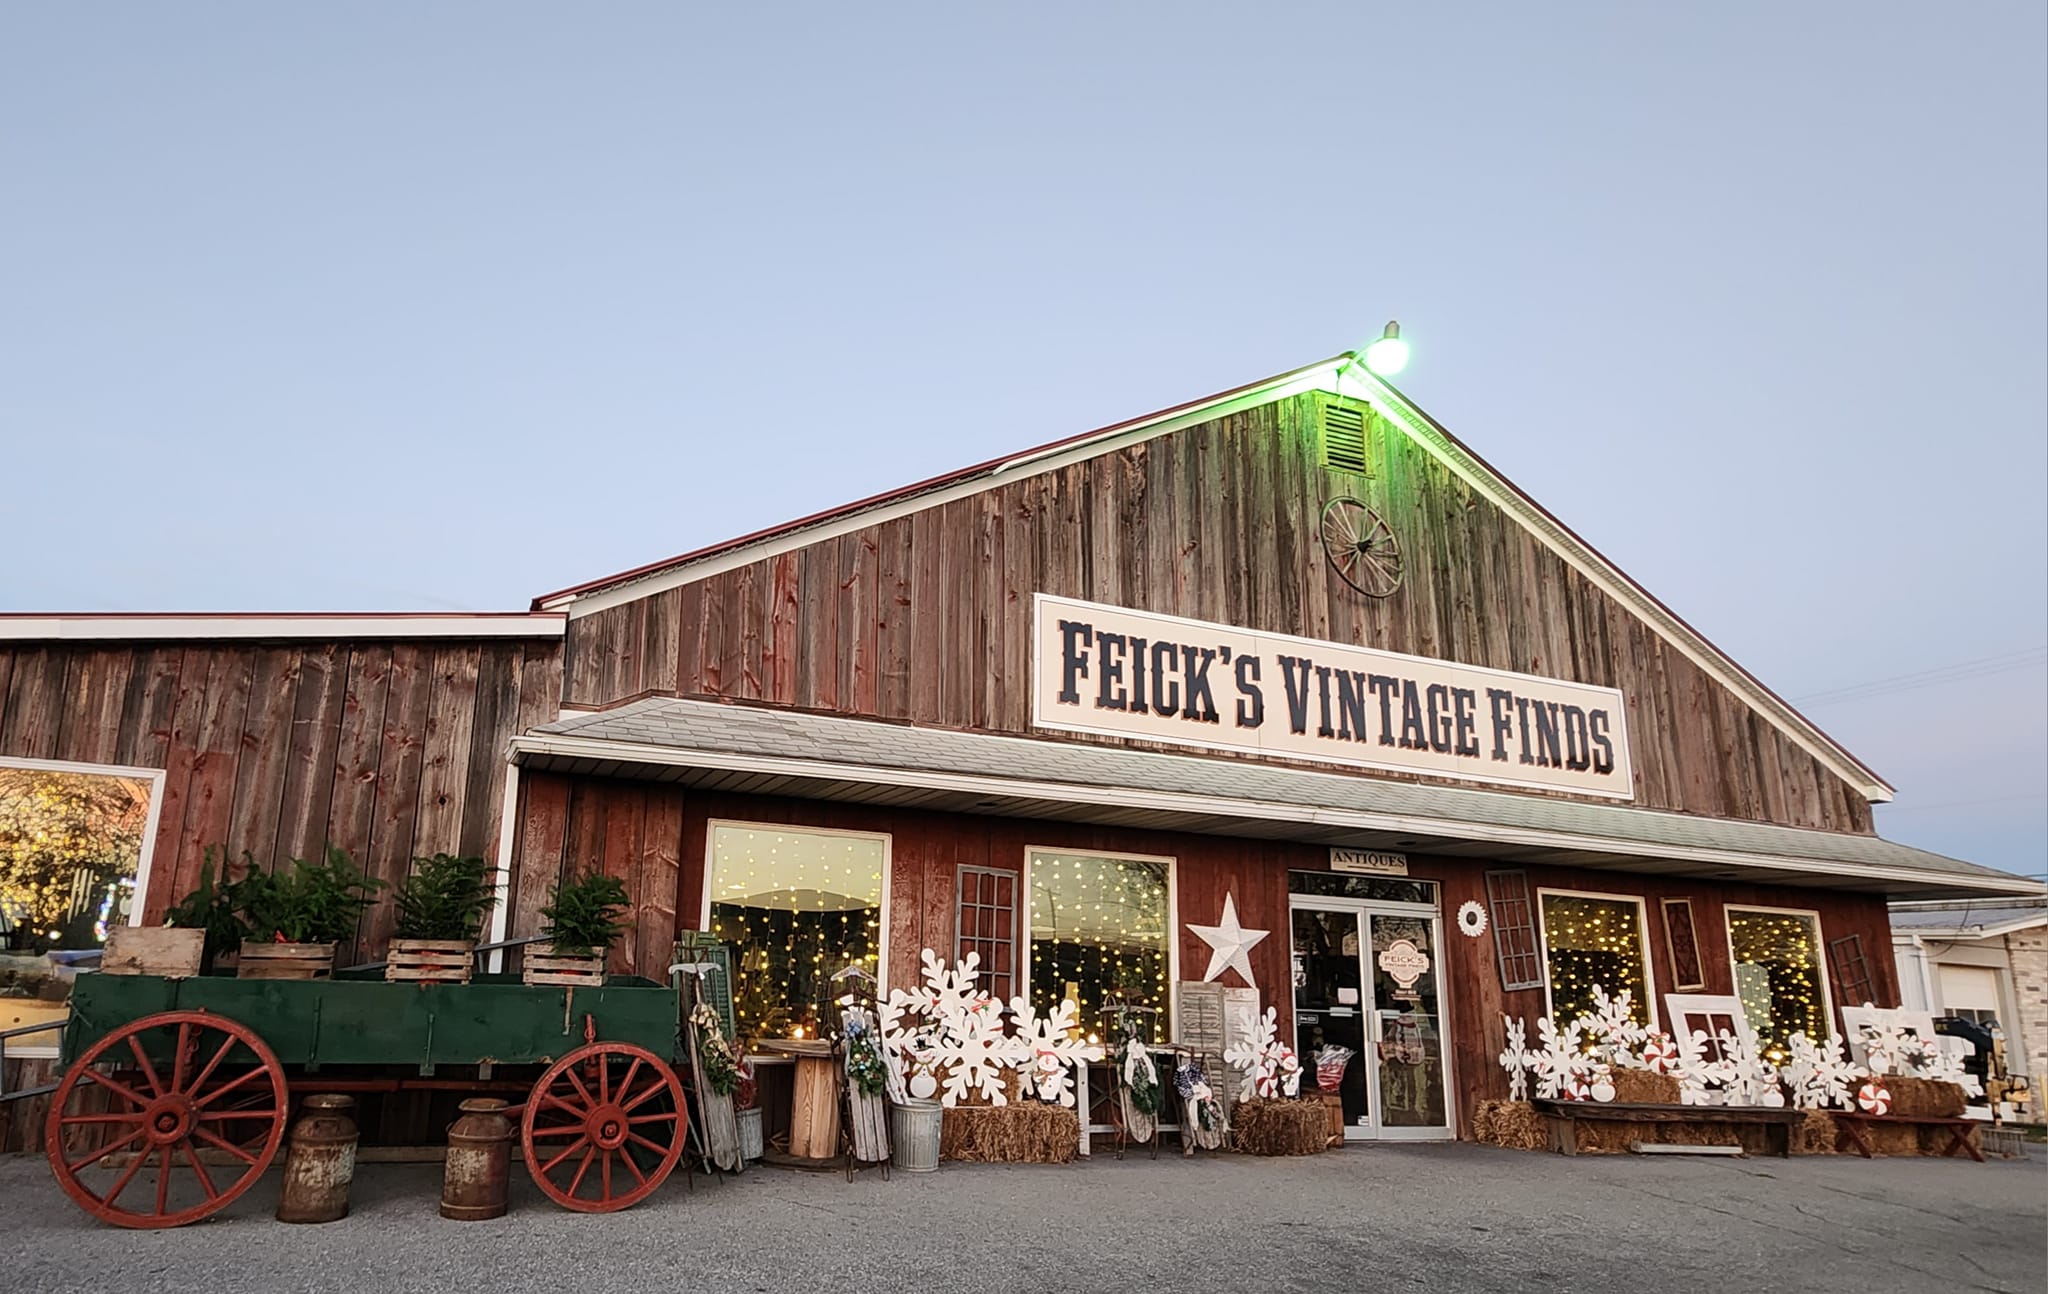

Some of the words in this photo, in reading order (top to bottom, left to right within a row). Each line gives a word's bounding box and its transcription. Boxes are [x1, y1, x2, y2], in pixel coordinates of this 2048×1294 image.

[1057, 619, 1265, 729] FEICK'S
[1278, 654, 1480, 758] VINTAGE
[1486, 687, 1616, 776] FINDS
[1332, 851, 1406, 868] ANTIQUES
